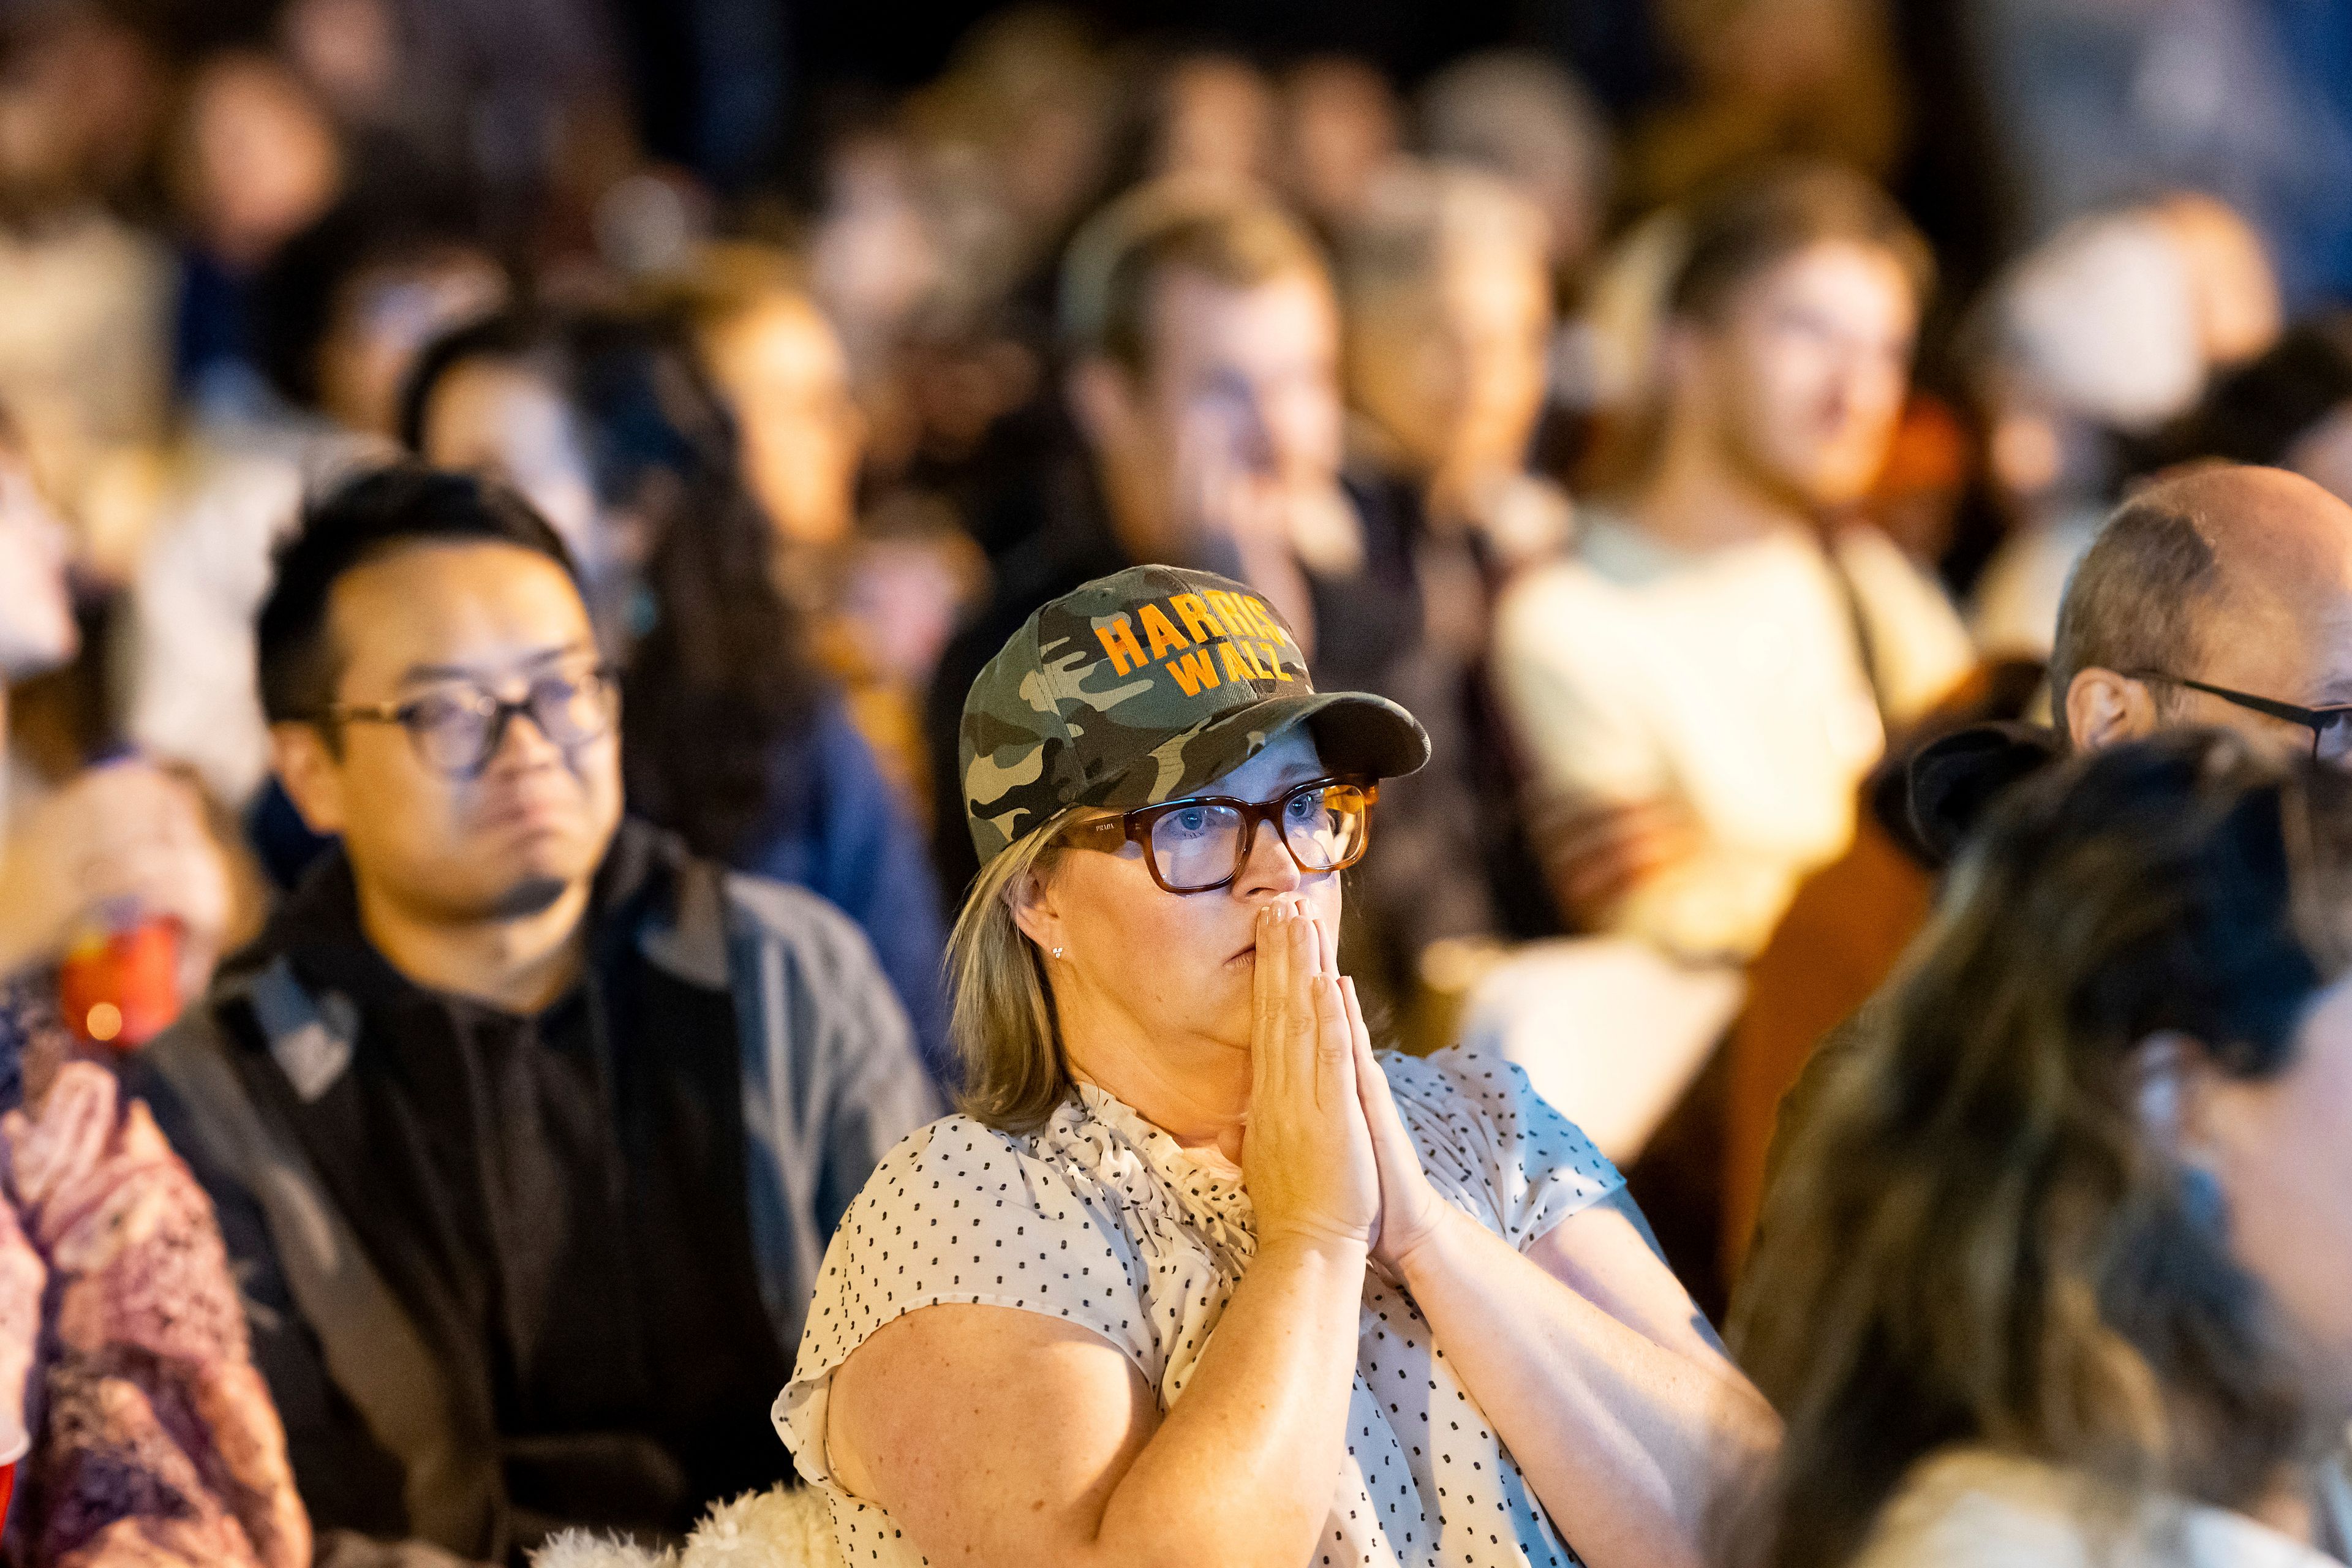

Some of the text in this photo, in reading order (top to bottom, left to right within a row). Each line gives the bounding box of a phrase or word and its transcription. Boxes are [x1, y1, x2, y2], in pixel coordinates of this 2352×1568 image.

[1095, 590, 1286, 677] HARRIS
[1165, 641, 1294, 696] WALZ
[1096, 823, 1115, 832] PRADA
